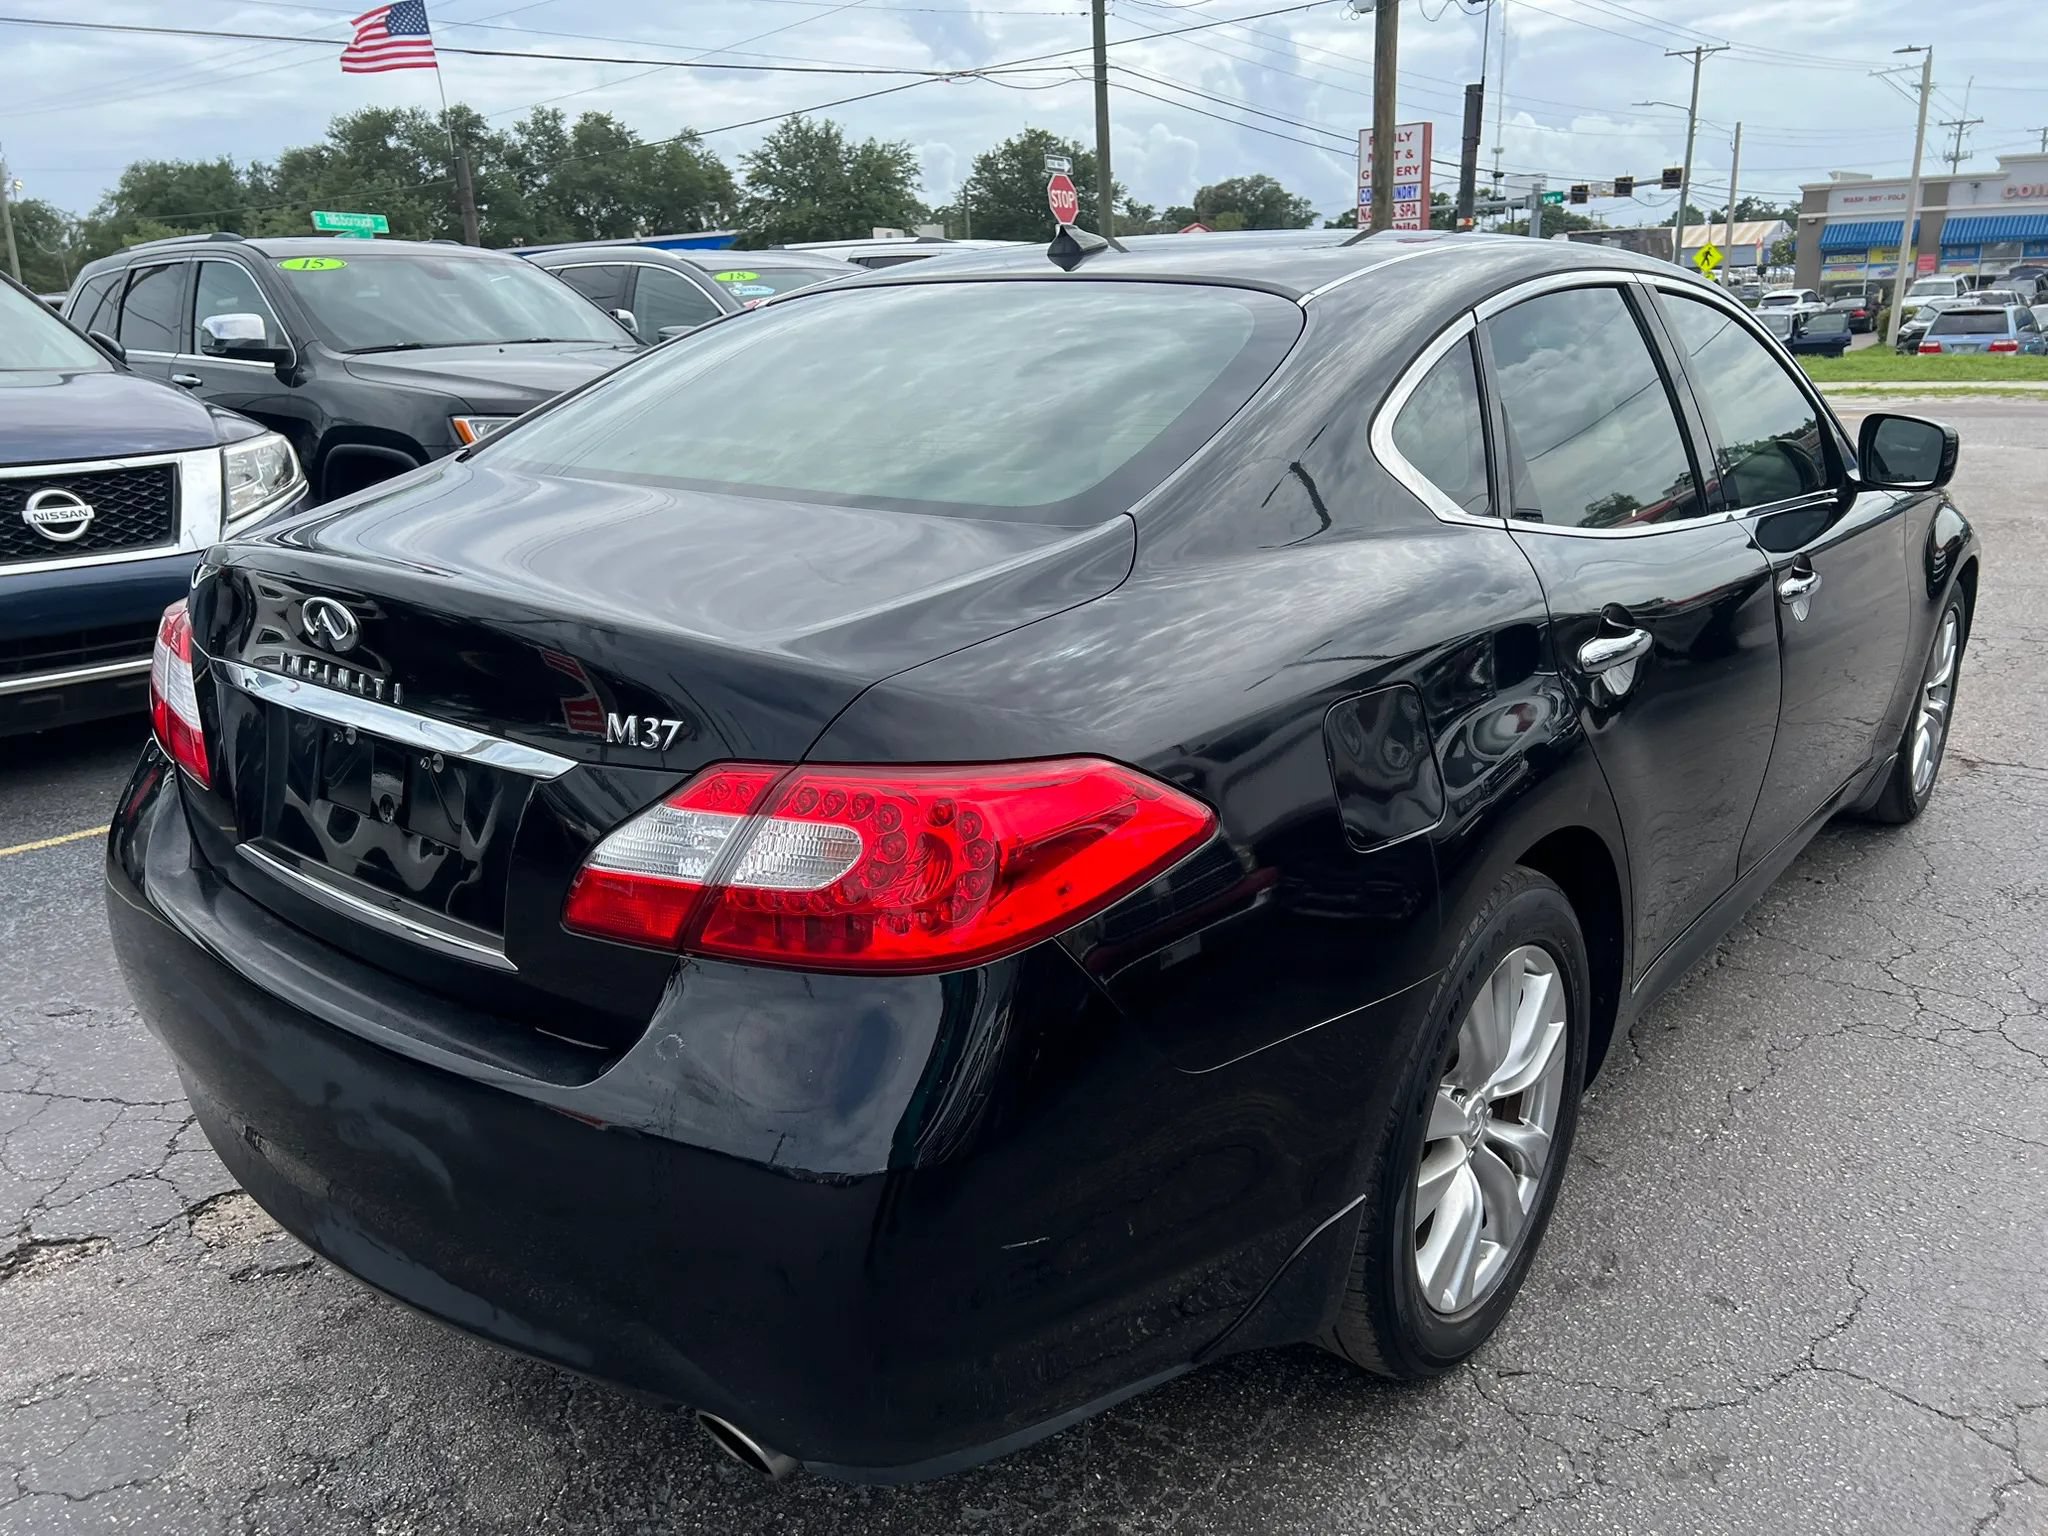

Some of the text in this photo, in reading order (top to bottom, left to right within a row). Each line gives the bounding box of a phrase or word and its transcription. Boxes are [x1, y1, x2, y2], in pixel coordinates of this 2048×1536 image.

[1369, 131, 1413, 146] FILY
[1405, 149, 1413, 159] &
[1362, 165, 1420, 180] GERY
[1051, 189, 1075, 208] STOP
[1400, 203, 1417, 217] SPA
[302, 259, 325, 269] 15
[33, 509, 88, 521] NISSAN
[280, 652, 404, 705] INFINITI
[606, 712, 684, 751] M37
